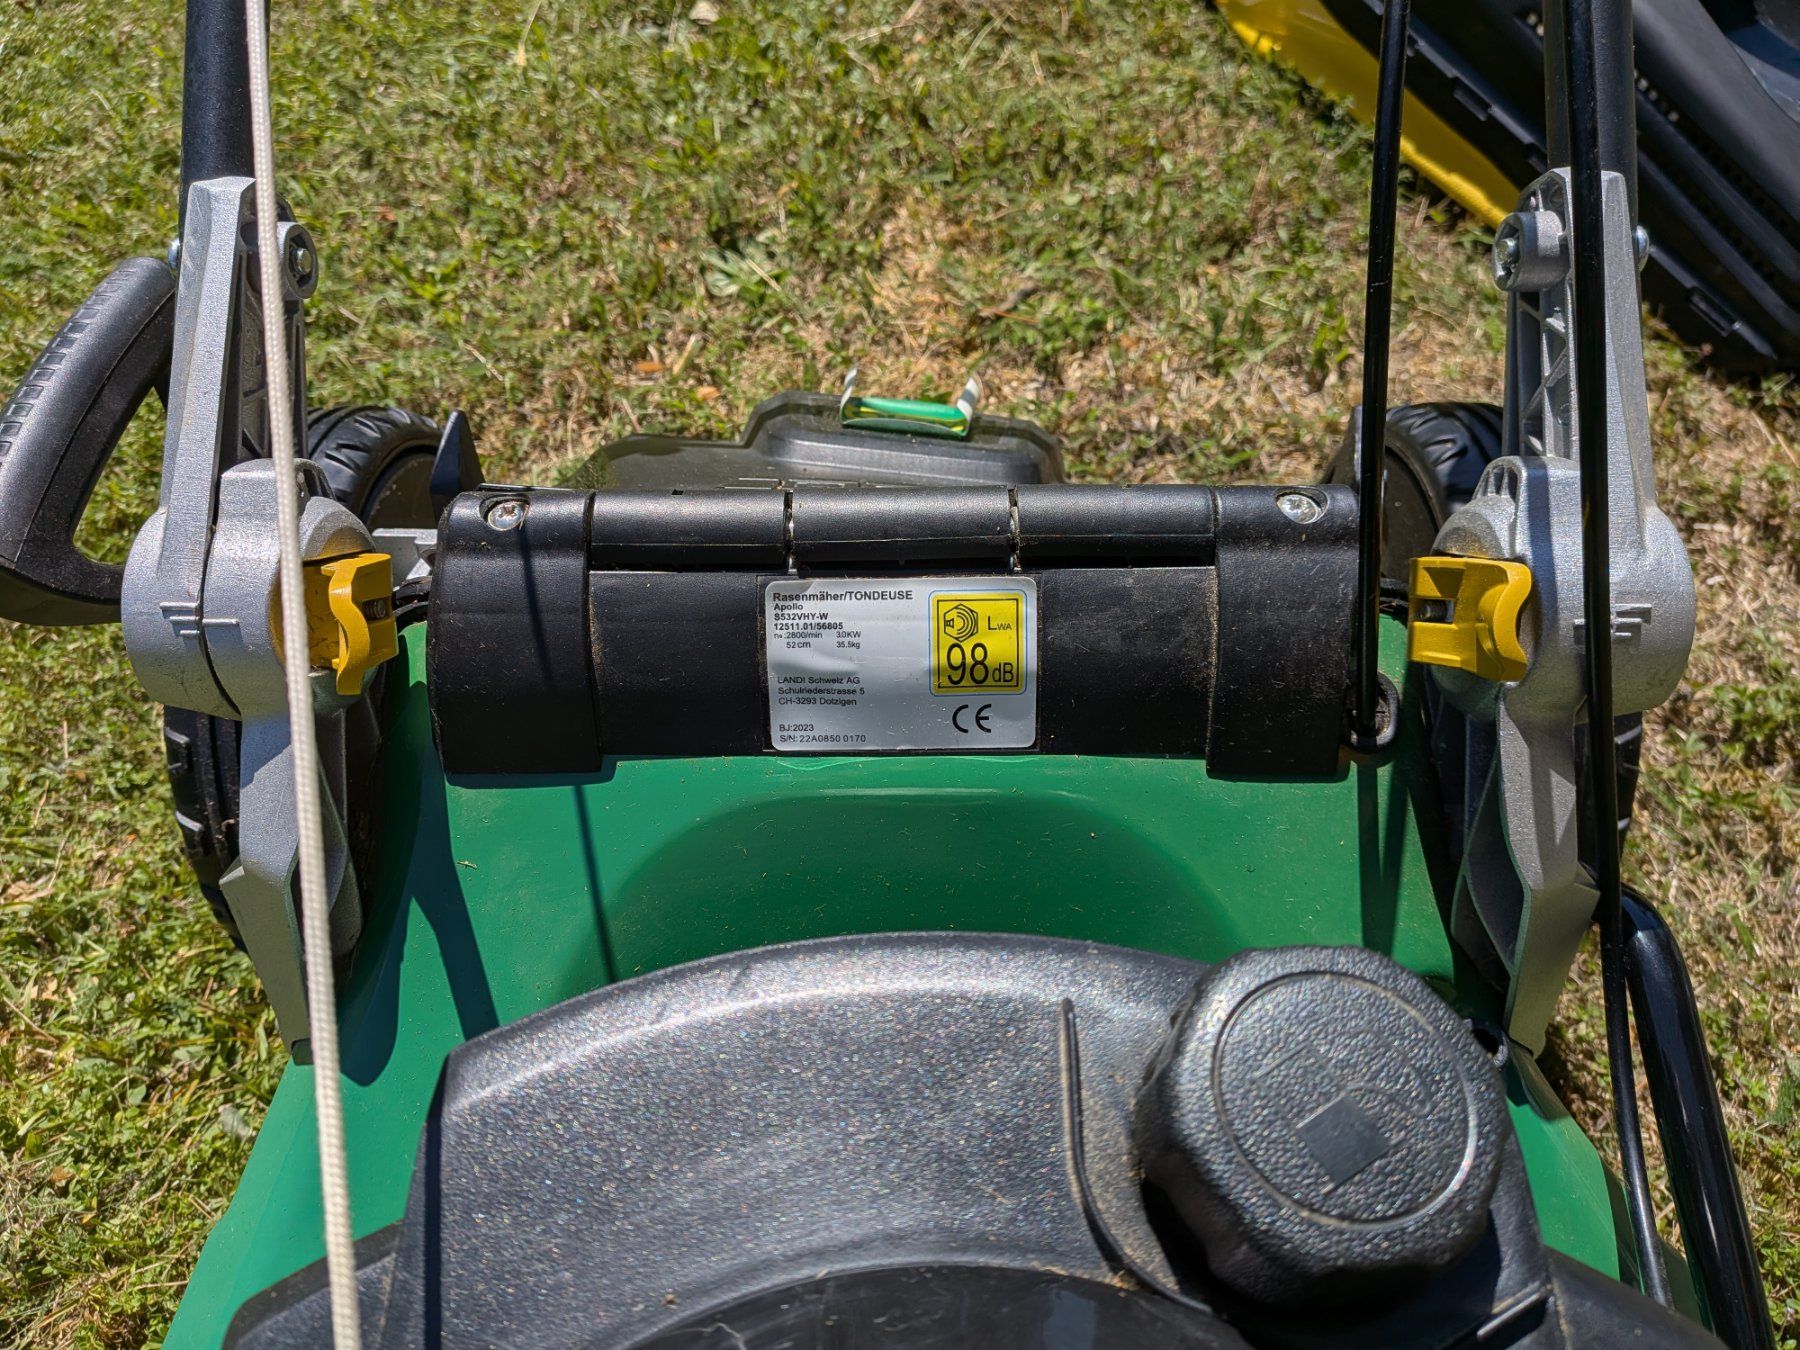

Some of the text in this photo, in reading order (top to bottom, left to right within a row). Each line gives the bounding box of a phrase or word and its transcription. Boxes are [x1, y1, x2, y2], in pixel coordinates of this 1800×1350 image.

[773, 590, 913, 602] Rasenmäher/TONDEUSE
[774, 603, 803, 612] Apollo
[774, 622, 843, 630] 12511.01/56805
[836, 641, 860, 649] 35.5kg
[946, 643, 1014, 685] 98 dB
[820, 698, 856, 706] Dotzigen
